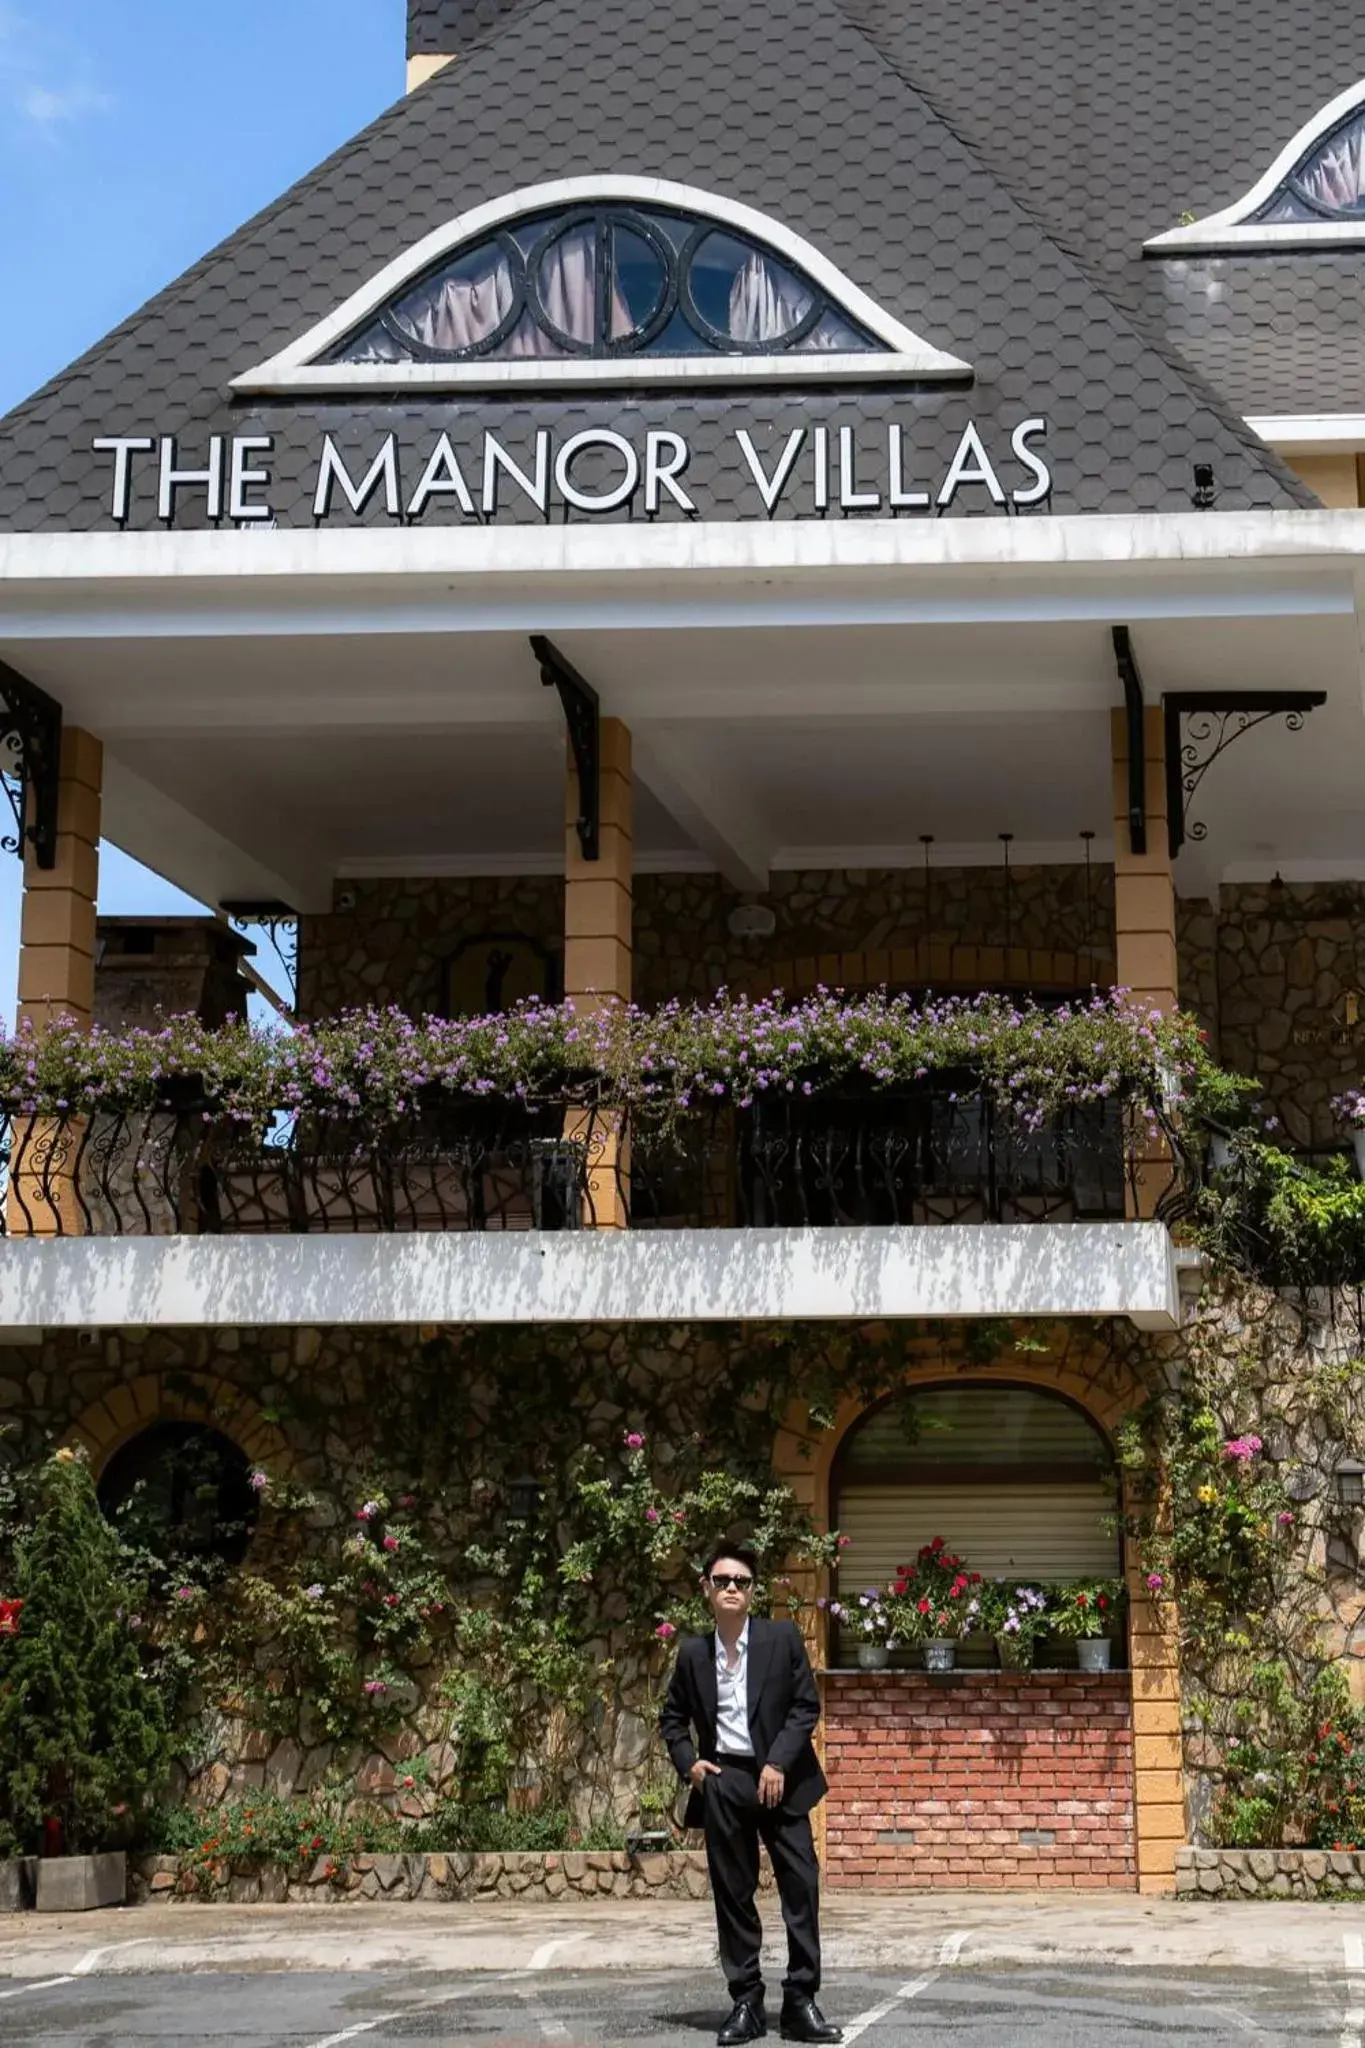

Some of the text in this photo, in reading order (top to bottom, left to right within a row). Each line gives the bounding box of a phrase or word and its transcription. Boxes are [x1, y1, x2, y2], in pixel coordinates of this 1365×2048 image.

[92, 418, 1053, 522] THE MANOR VILLAS
